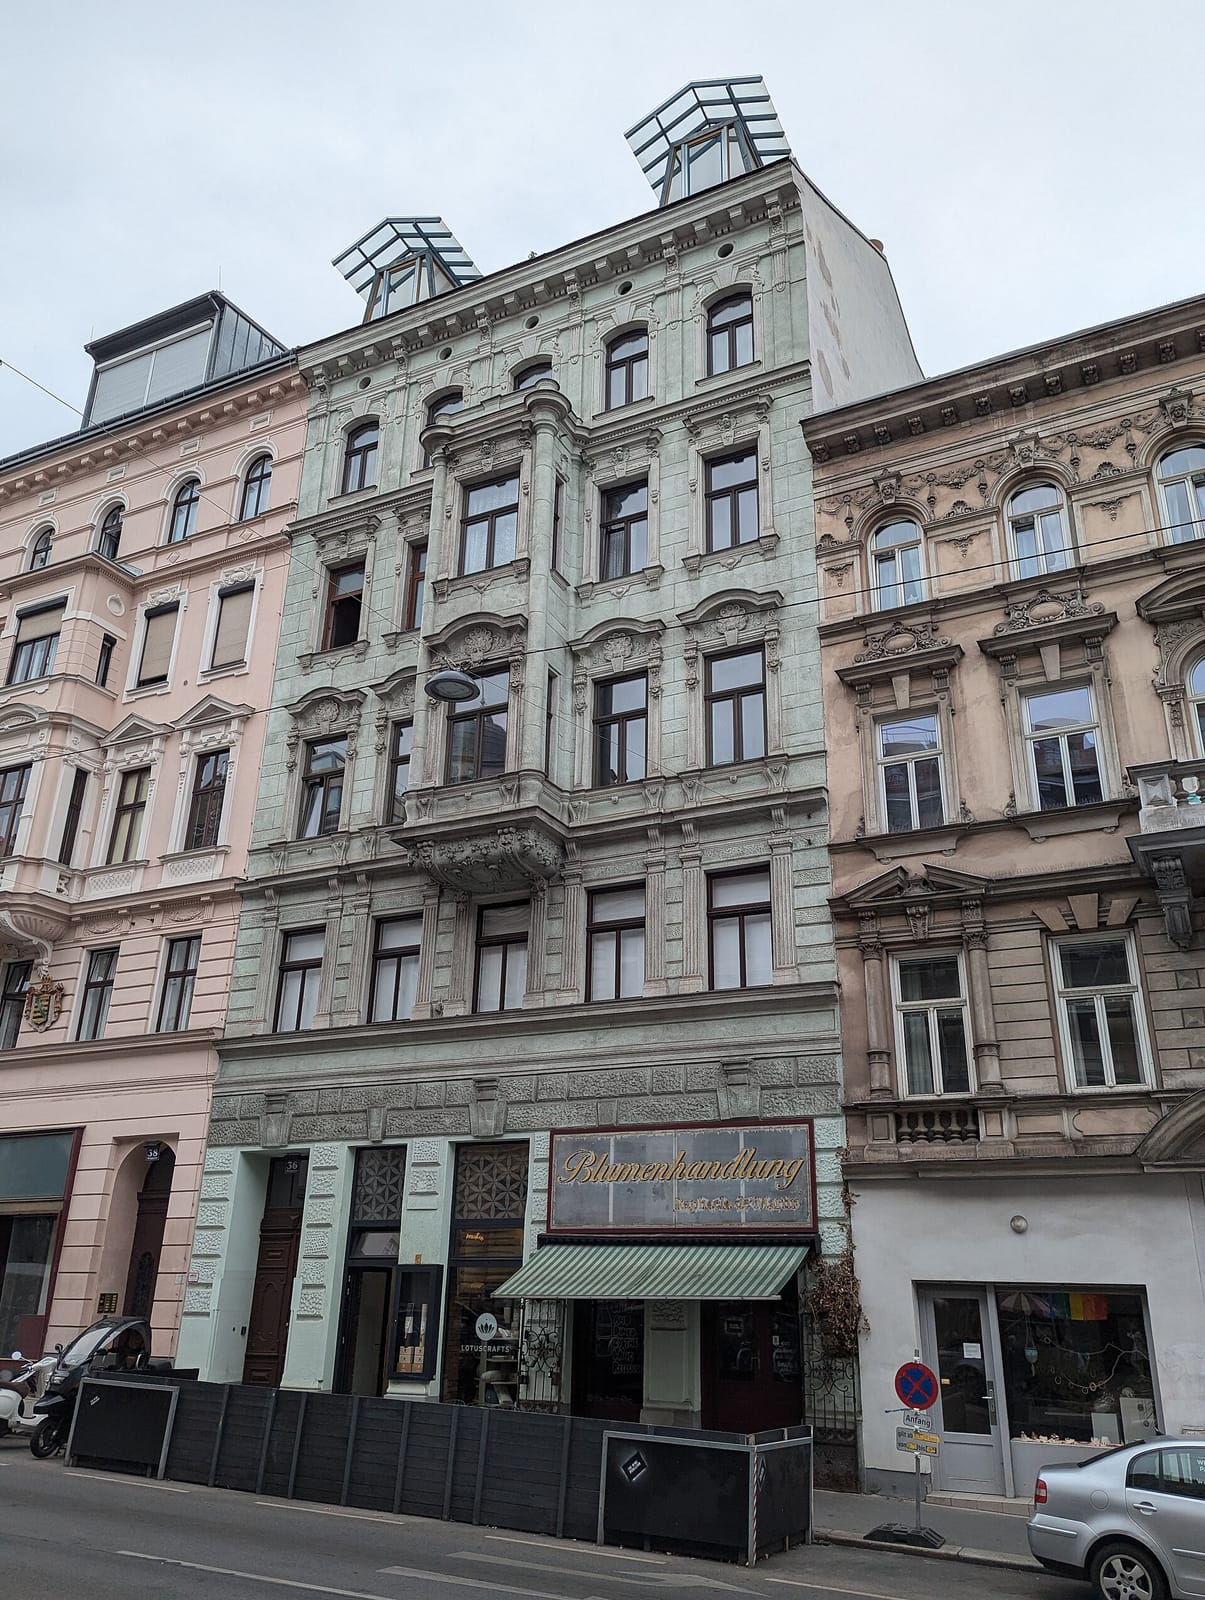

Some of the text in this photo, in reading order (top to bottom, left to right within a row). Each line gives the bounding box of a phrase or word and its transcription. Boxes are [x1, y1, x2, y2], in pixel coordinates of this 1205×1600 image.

[146, 1148, 158, 1157] 38
[286, 1161, 298, 1170] 36
[556, 1147, 804, 1191] Blumenhandlung
[461, 1344, 510, 1353] LOTUSCRAFTS
[905, 1414, 931, 1428] Anfang
